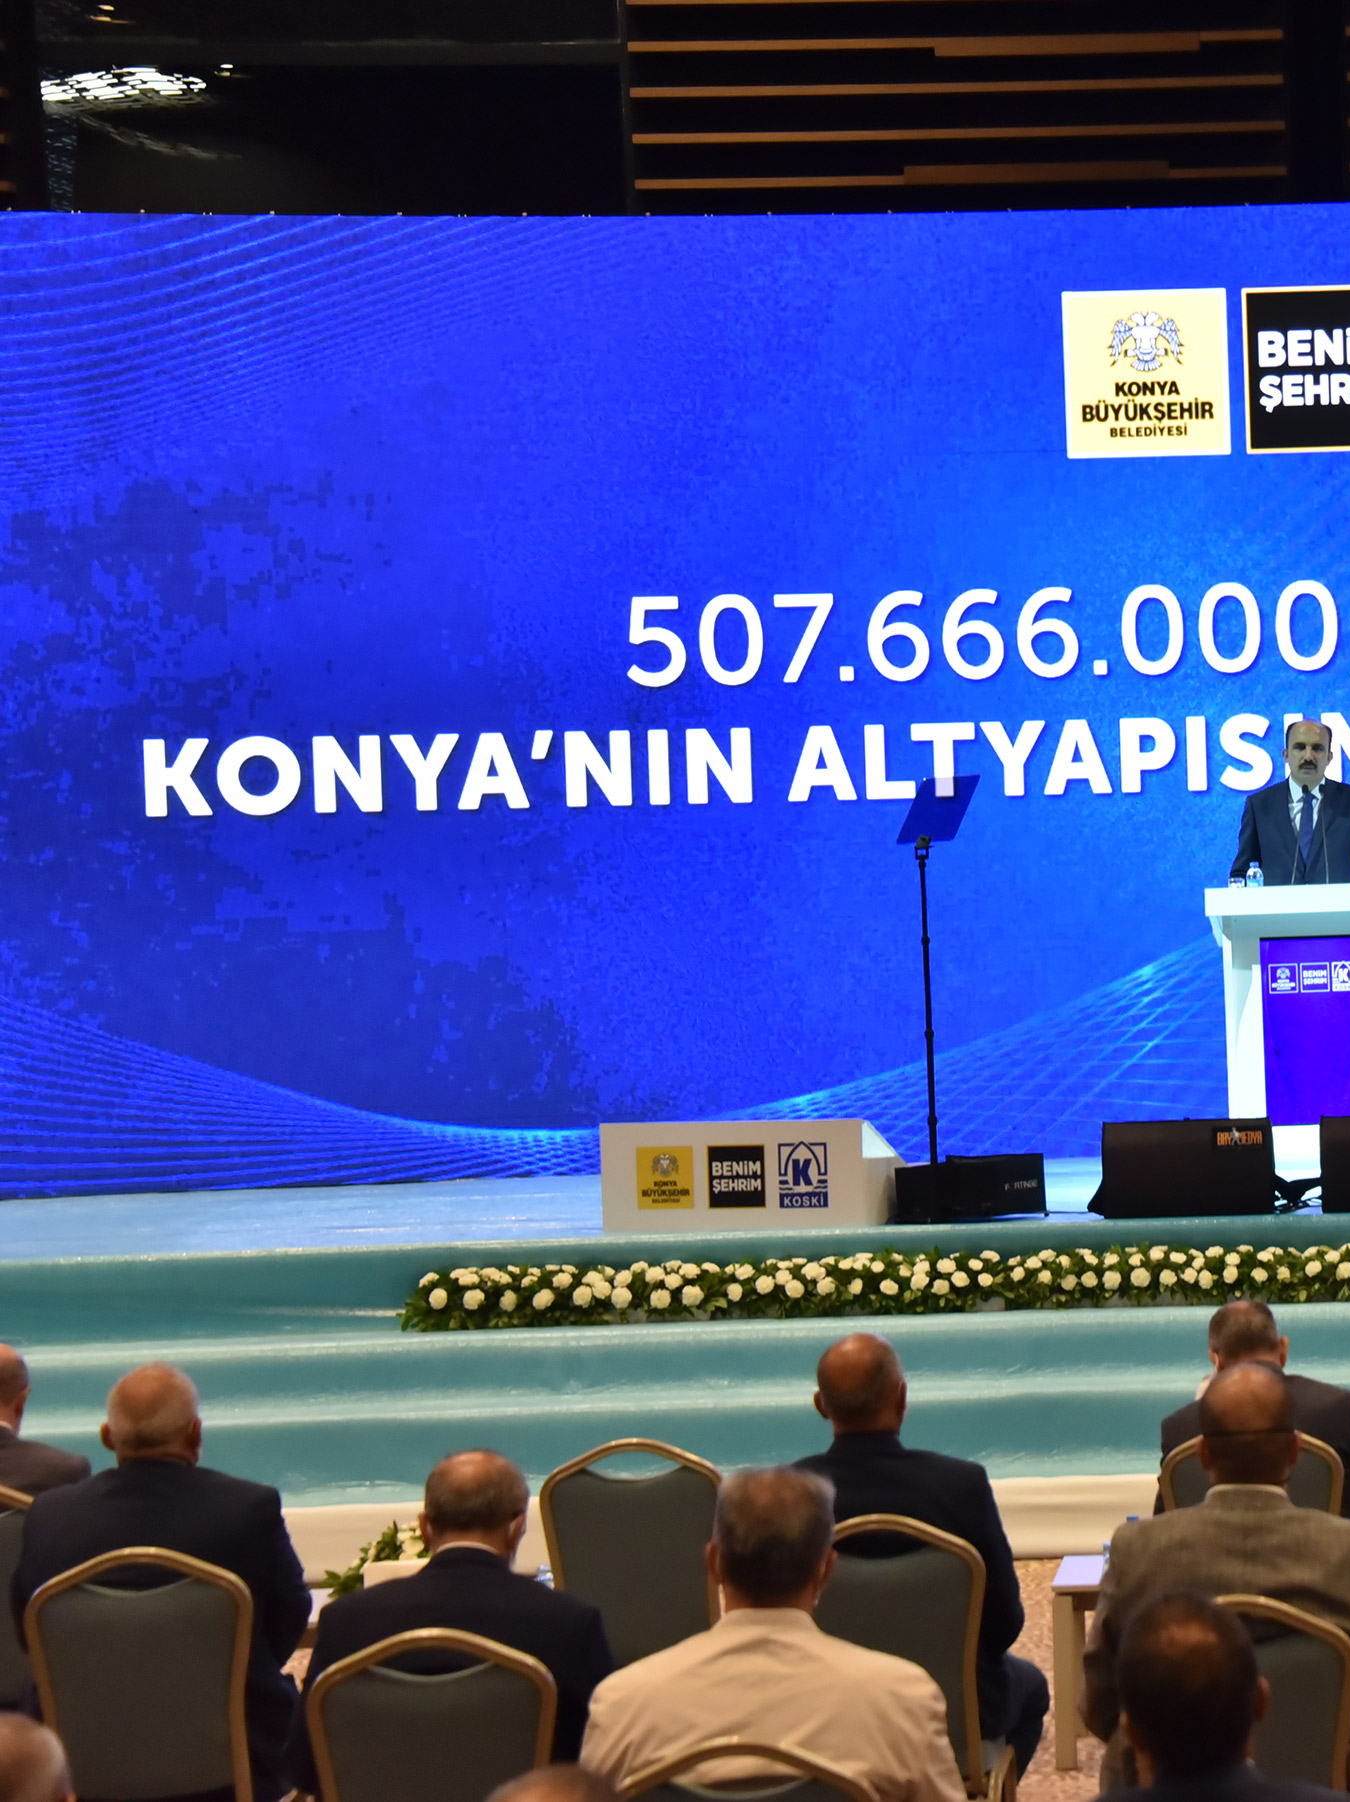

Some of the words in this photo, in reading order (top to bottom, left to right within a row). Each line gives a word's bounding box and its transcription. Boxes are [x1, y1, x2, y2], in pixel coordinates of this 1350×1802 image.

[1114, 381, 1180, 397] KONYA
[1081, 397, 1214, 423] BÜYÜKŞEHİR
[1109, 422, 1188, 438] BELEDİYESİ
[627, 579, 1338, 688] 507.666.000
[143, 727, 753, 818] KONYA'NIN
[712, 1160, 762, 1177] BENİM
[792, 1158, 814, 1187] K
[653, 1180, 678, 1188] KONYA
[712, 1177, 762, 1194] ŞEHRİM
[783, 1193, 824, 1208] KOSKİ
